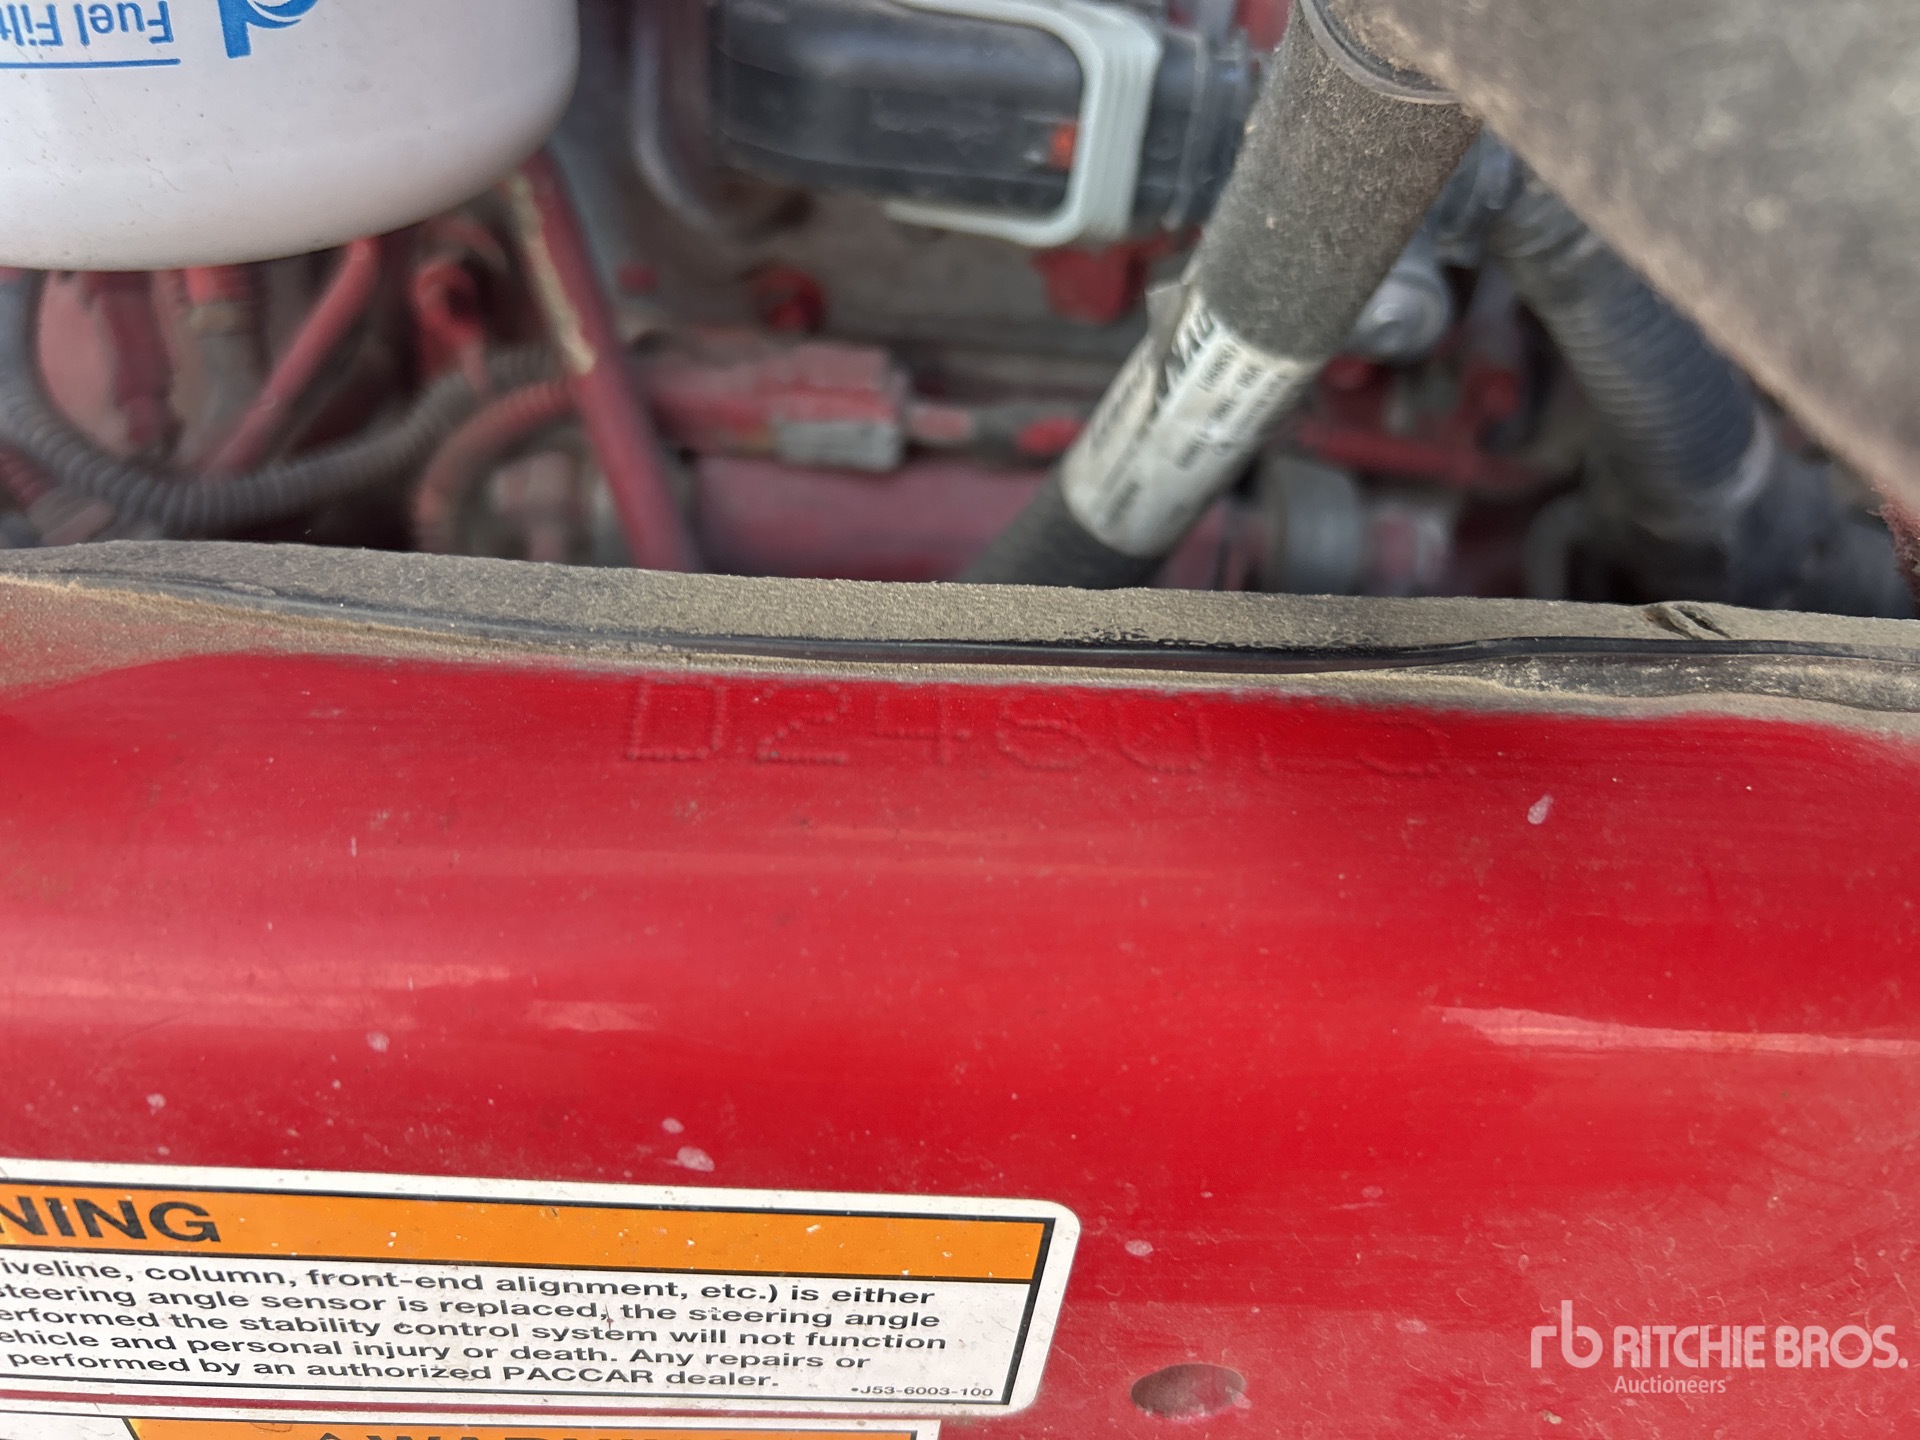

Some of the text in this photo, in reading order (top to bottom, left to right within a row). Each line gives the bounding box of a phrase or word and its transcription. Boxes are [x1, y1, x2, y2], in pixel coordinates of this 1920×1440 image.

[72, 0, 174, 47] Fuel
[145, 1265, 297, 1288] column,
[305, 1268, 485, 1292] front-end
[496, 1275, 688, 1300] alignment,
[700, 1283, 778, 1304] etc.)
[791, 1285, 819, 1302] is
[831, 1285, 936, 1305] either
[147, 1290, 251, 1310] angle
[260, 1294, 387, 1312] sensor
[398, 1296, 429, 1313] is
[439, 1299, 608, 1321] replaced,
[620, 1304, 678, 1322] the
[688, 1307, 834, 1328] steering
[843, 1311, 941, 1330] angle
[168, 1313, 228, 1330] the
[239, 1315, 381, 1337] stability
[393, 1321, 520, 1338] control
[531, 1324, 658, 1342] system
[669, 1326, 728, 1344] will
[739, 1330, 797, 1347] not
[805, 1330, 947, 1350] function
[8, 1353, 191, 1372] performed
[200, 1358, 241, 1376] by
[253, 1361, 296, 1376] an
[306, 1362, 493, 1381] authorized
[502, 1367, 654, 1385] PACCAR
[666, 1371, 780, 1388] dealer.
[110, 1335, 180, 1350] and
[187, 1338, 342, 1357] personal
[353, 1340, 451, 1361] injury
[462, 1346, 499, 1359] or
[509, 1345, 618, 1363] death.
[629, 1348, 695, 1367] Any
[705, 1351, 824, 1369] repairs
[835, 1355, 872, 1369] or
